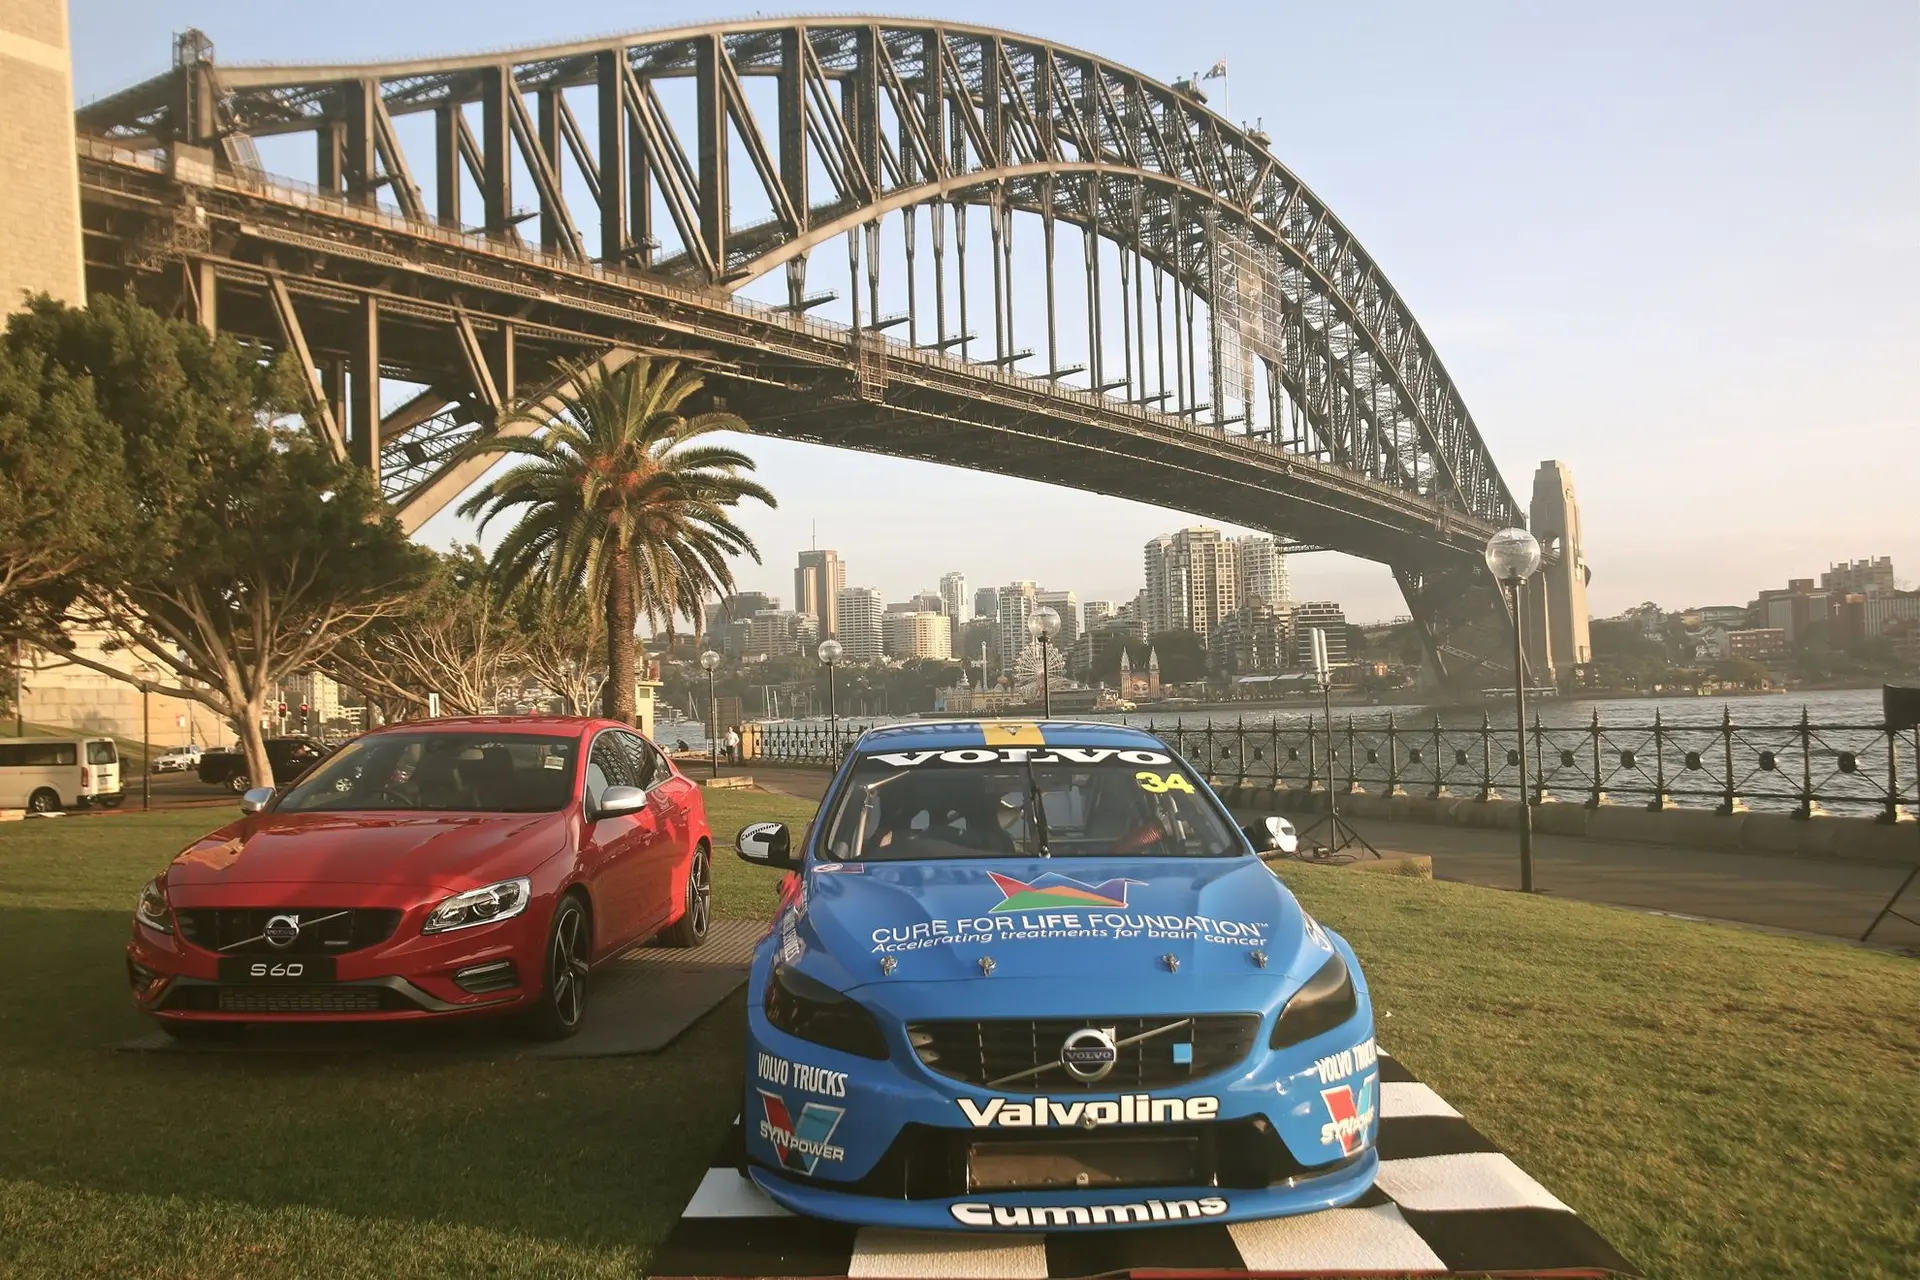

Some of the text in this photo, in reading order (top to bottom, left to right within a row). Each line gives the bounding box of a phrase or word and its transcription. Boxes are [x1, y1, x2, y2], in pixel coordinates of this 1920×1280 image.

[867, 748, 1172, 766] VOLVO
[1135, 771, 1195, 794] 34
[872, 920, 949, 943] CURE
[957, 916, 1014, 933] FOR
[1021, 914, 1081, 930] LIFE
[872, 927, 1268, 953] Accelerating treatments for brain cancer
[250, 963, 303, 976] S60
[1065, 1051, 1111, 1060] VOLVO
[1314, 1050, 1352, 1084] VOLVO
[758, 1052, 848, 1098] VOLVO TRUCKS
[957, 1094, 1219, 1126] Valvoline
[951, 1197, 1228, 1225] Cummins
